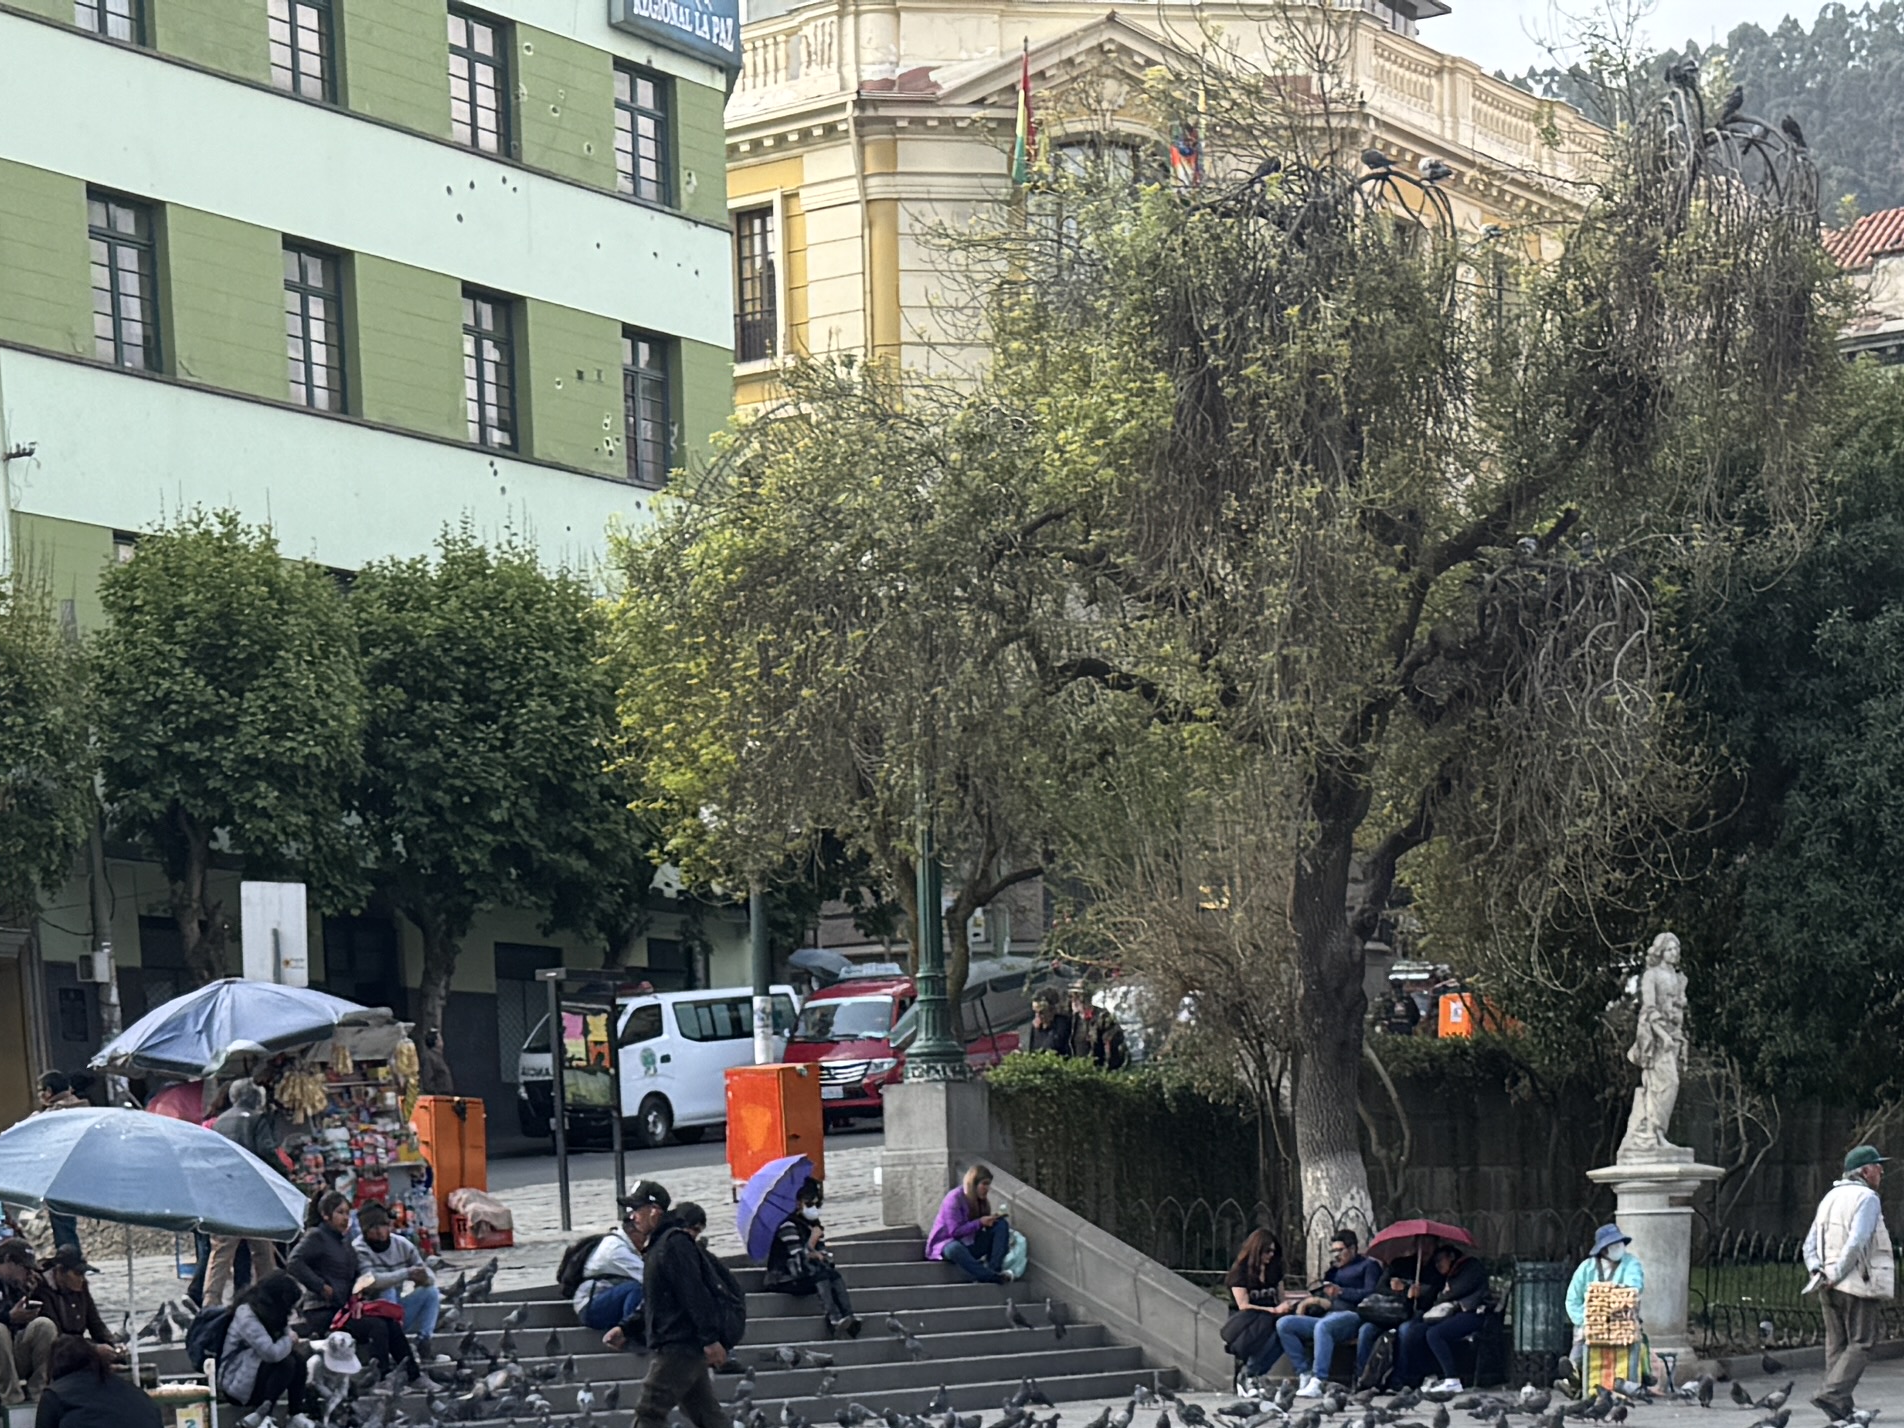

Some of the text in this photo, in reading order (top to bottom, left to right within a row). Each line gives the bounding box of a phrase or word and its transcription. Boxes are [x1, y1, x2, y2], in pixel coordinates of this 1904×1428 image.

[633, 0, 734, 53] REGIONAL LA PAZ
